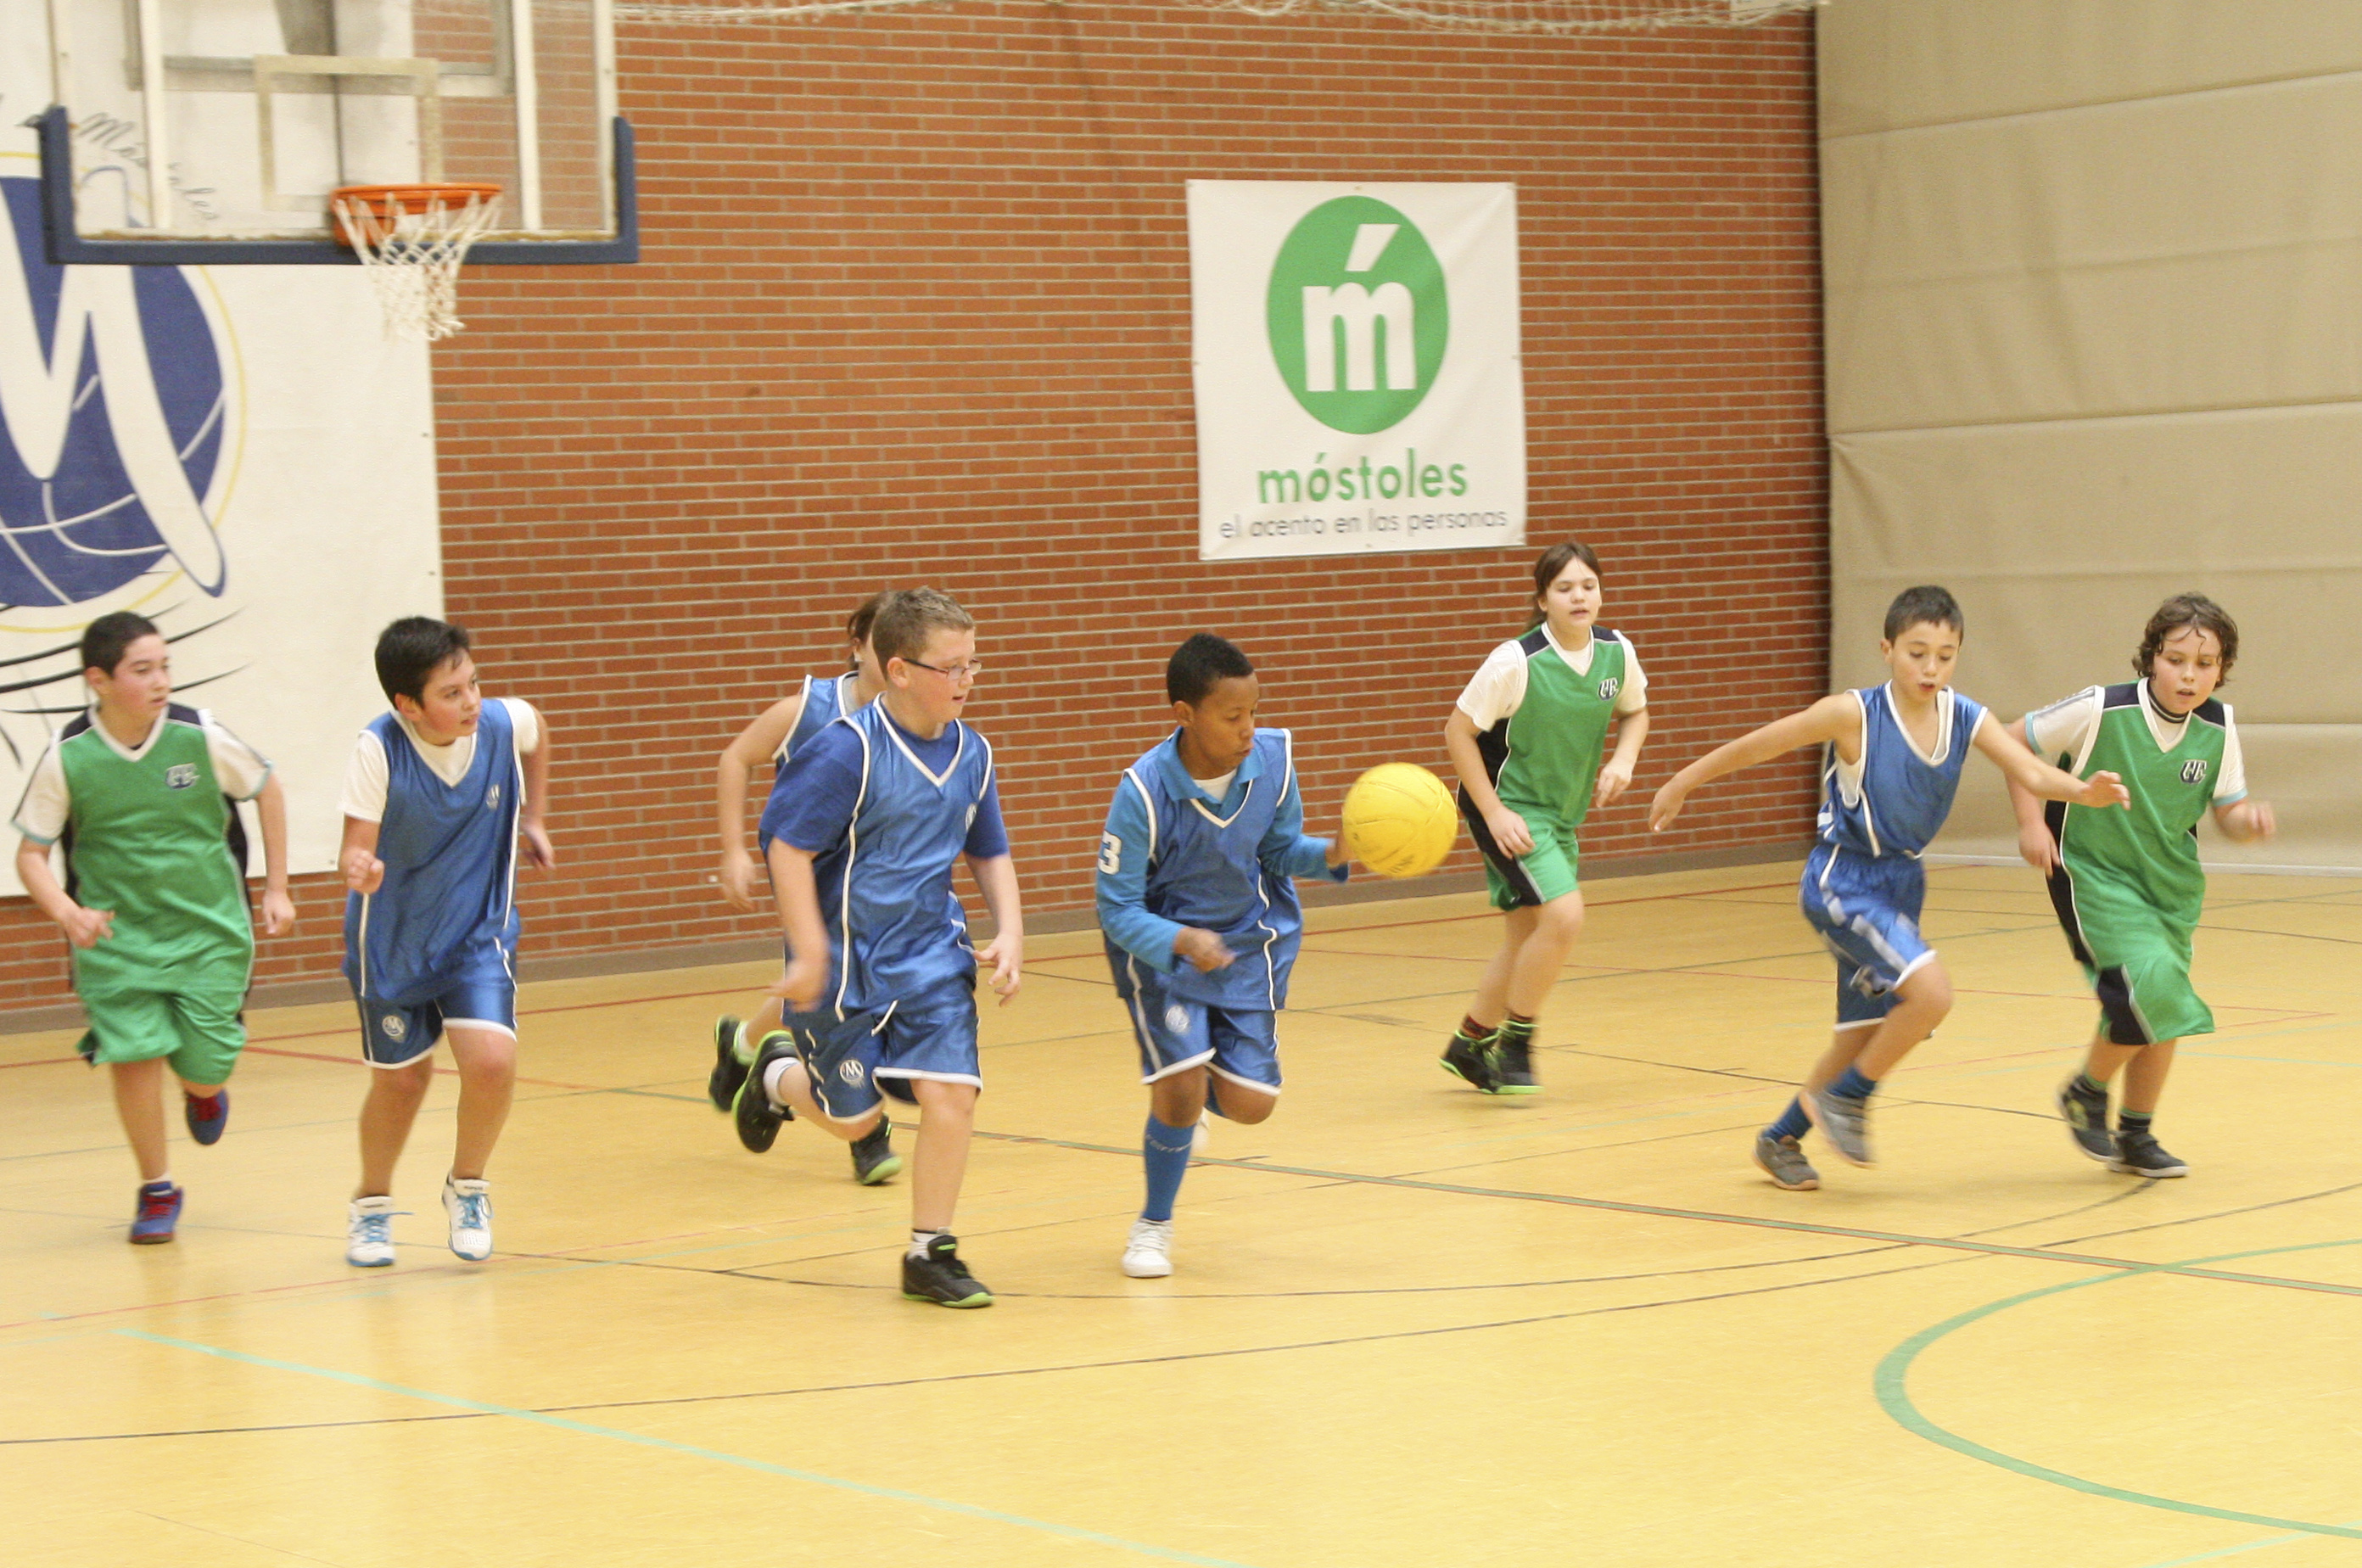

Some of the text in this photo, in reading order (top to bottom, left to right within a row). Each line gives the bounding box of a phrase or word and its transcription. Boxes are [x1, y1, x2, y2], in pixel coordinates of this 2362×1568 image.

[1257, 447, 1469, 504] móstoles
[1219, 508, 1508, 538] el acento en las personas
[1098, 830, 1122, 875] 3
